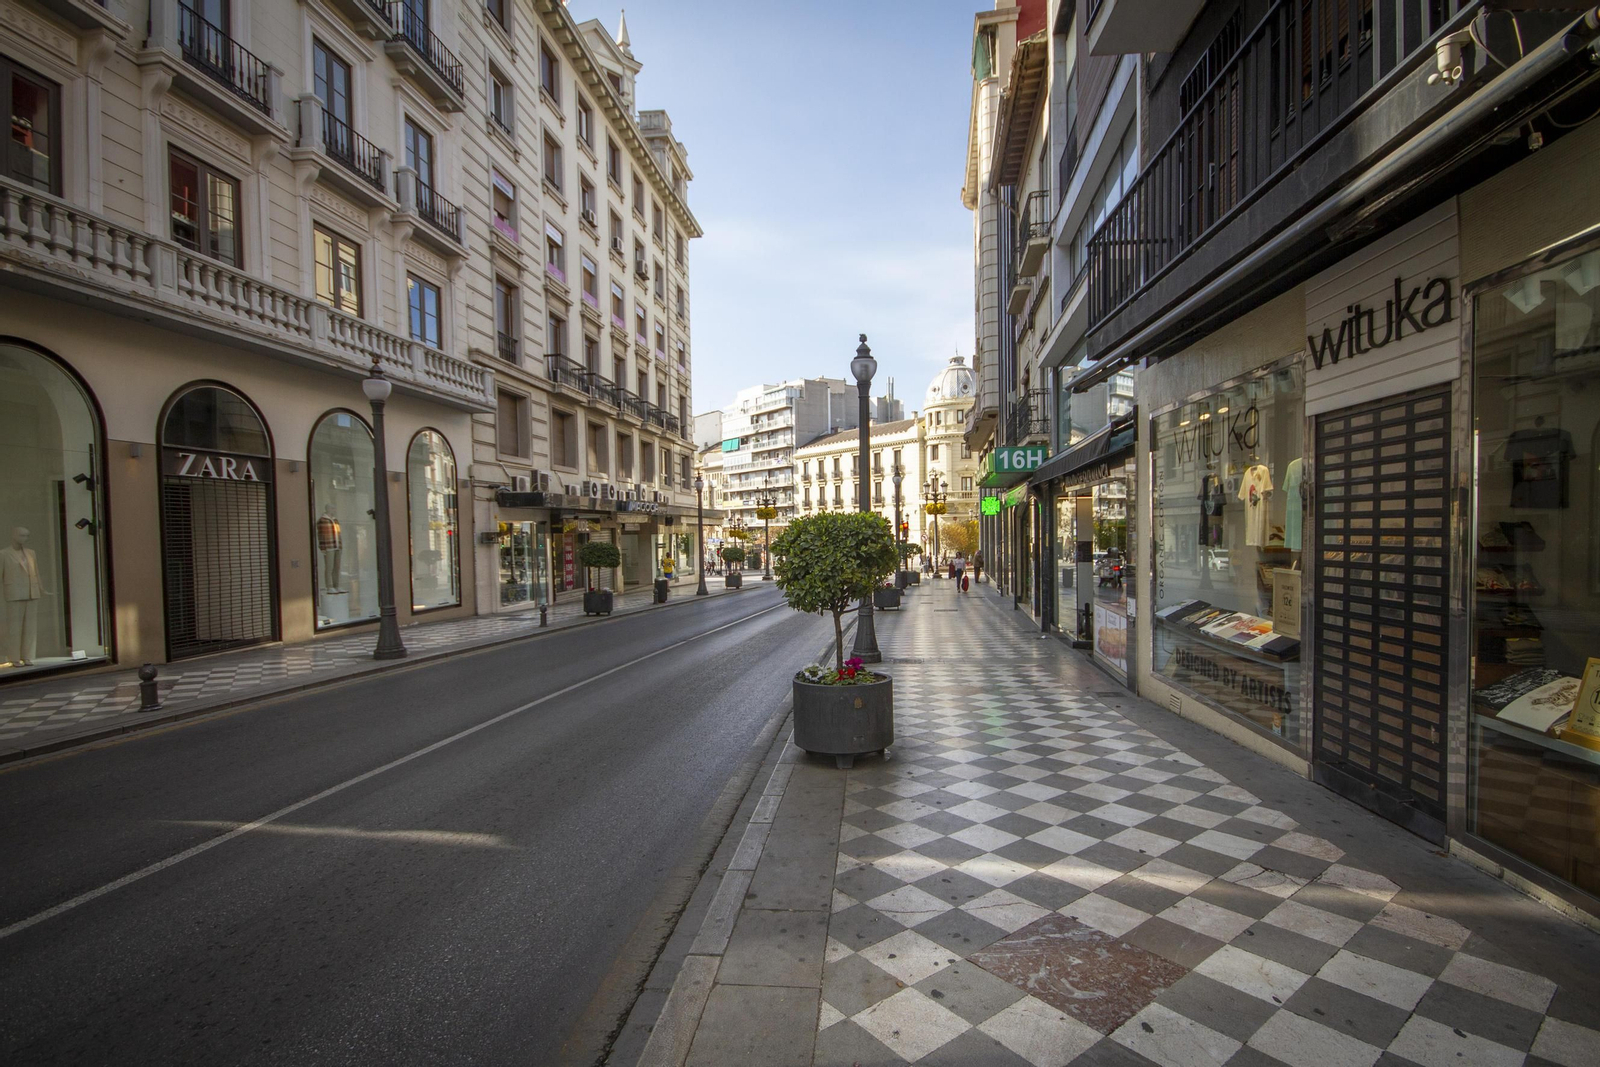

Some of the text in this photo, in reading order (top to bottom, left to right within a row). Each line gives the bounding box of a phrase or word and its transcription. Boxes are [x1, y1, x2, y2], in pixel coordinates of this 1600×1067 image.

[1307, 276, 1453, 371] wituka
[999, 449, 1043, 470] 16H
[1173, 397, 1260, 465] wituka
[178, 452, 259, 481] ZARA
[1175, 646, 1292, 714] DESIGNED BY ARTISTS
